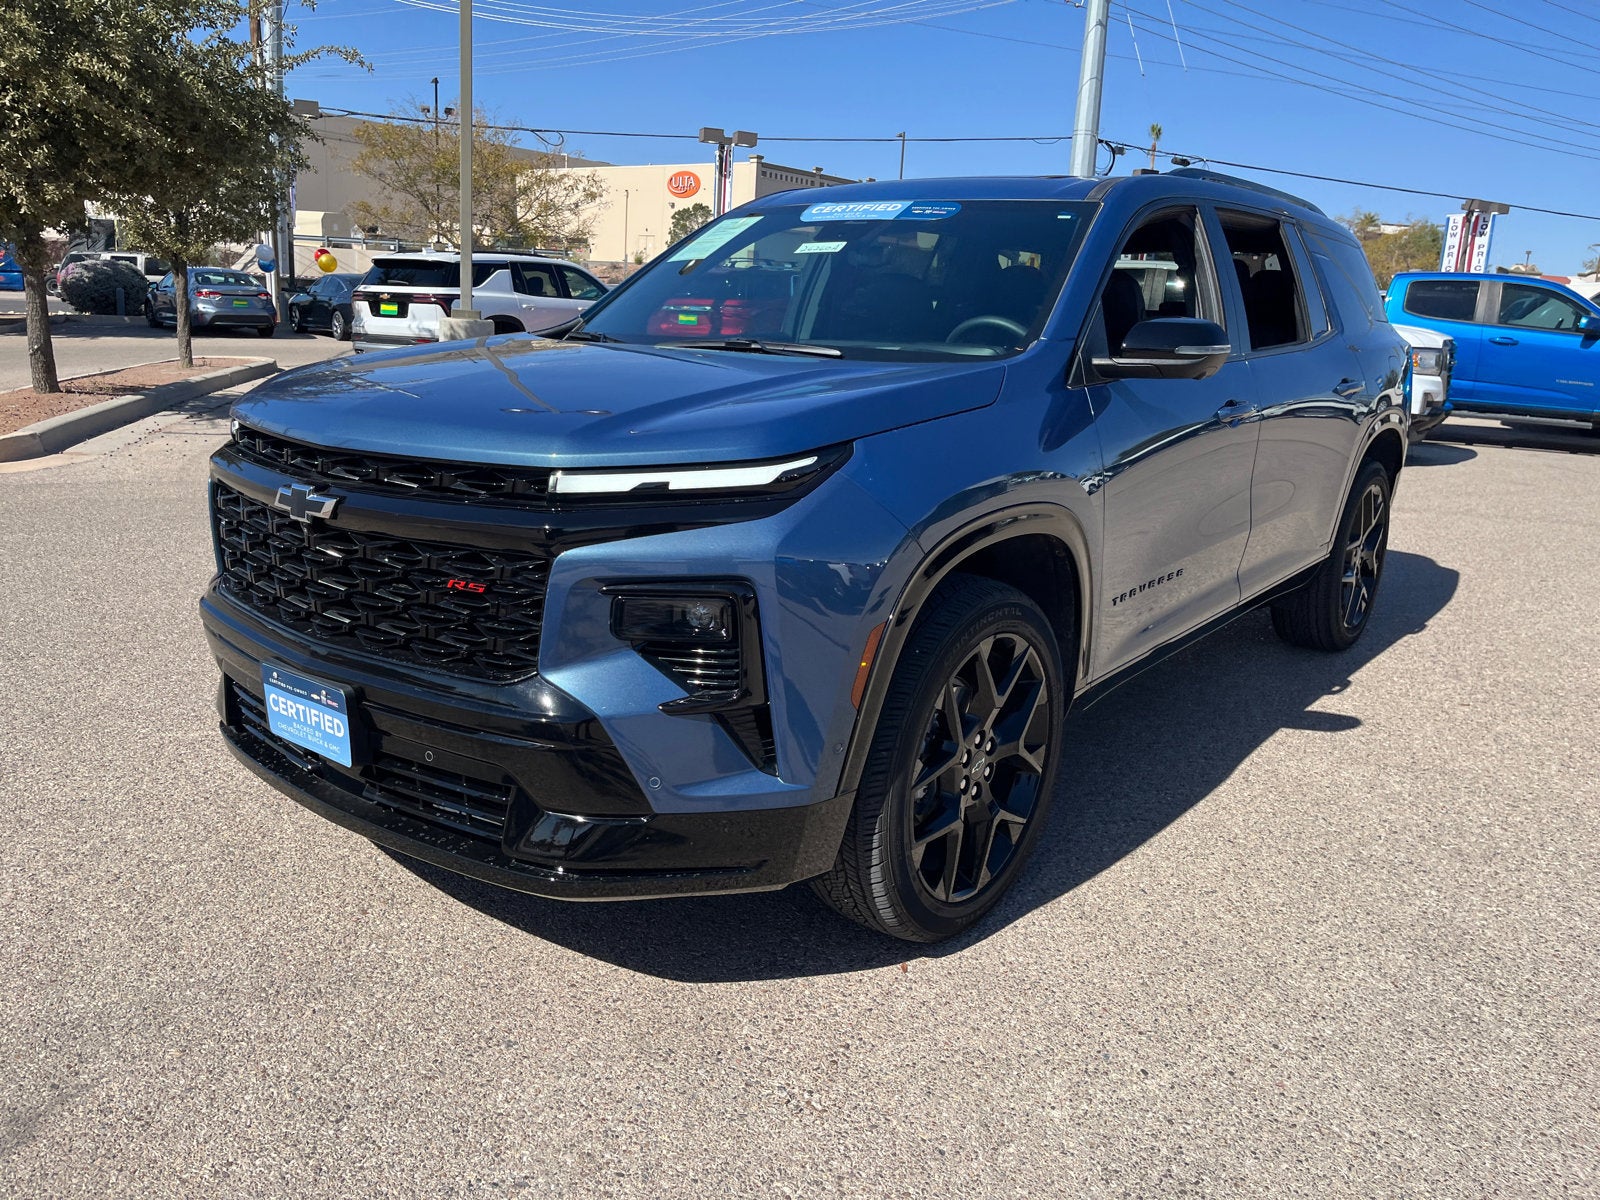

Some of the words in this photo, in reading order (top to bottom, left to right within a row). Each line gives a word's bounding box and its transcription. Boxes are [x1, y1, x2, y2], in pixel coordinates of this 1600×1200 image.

[672, 176, 695, 187] ULTA
[811, 203, 902, 214] CERTIFIED
[1450, 218, 1458, 238] LOW
[1479, 216, 1489, 237] LOW
[447, 579, 487, 593] RS
[1111, 568, 1184, 606] TRAVERSE
[269, 693, 345, 737] CERTIFIED
[277, 722, 307, 739] CHEVROLET
[308, 734, 323, 746] BUICK
[329, 743, 340, 754] GMC
[292, 722, 314, 735] BACKED
